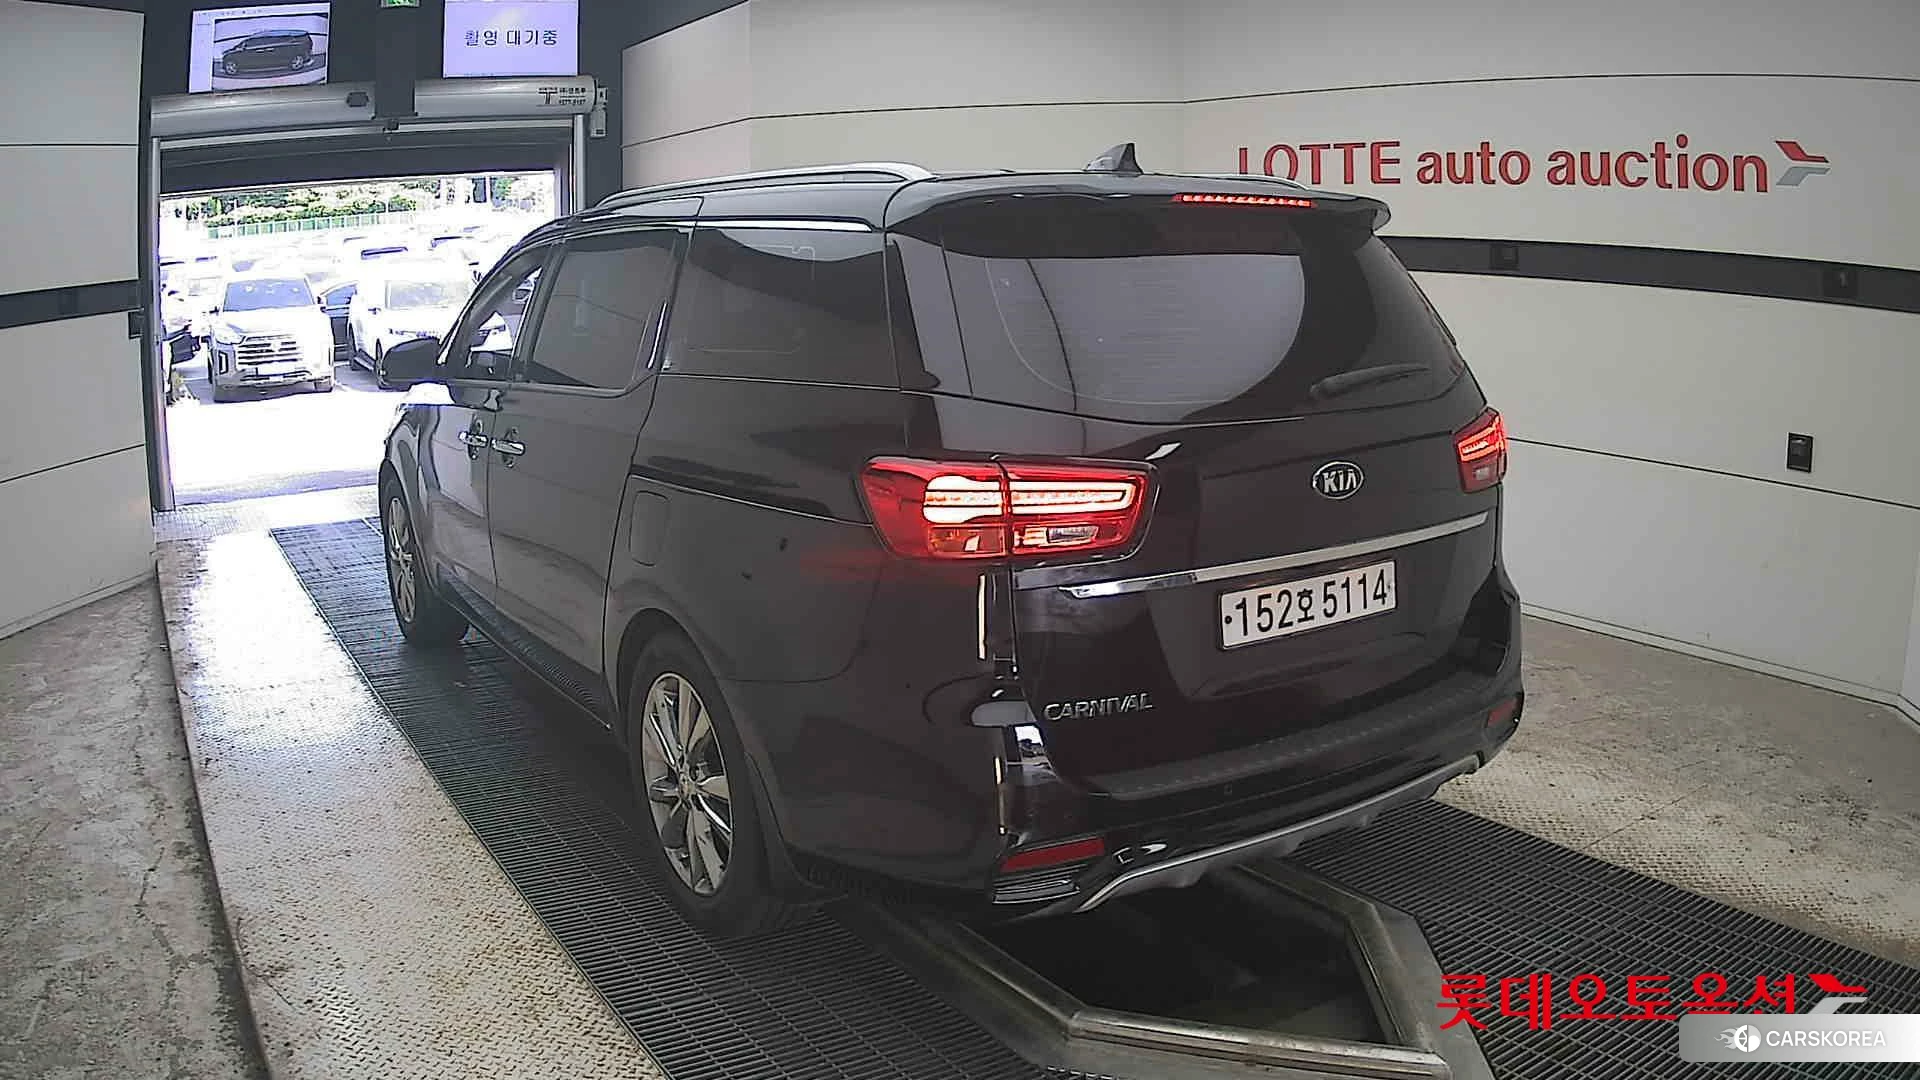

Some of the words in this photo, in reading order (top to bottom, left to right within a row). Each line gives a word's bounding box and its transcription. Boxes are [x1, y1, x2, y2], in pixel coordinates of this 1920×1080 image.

[506, 30, 558, 46] 대기중
[1416, 141, 1531, 186] auto
[1547, 134, 1768, 193] auction
[1322, 468, 1357, 494] KIA
[1044, 692, 1153, 720] CARNIVAL
